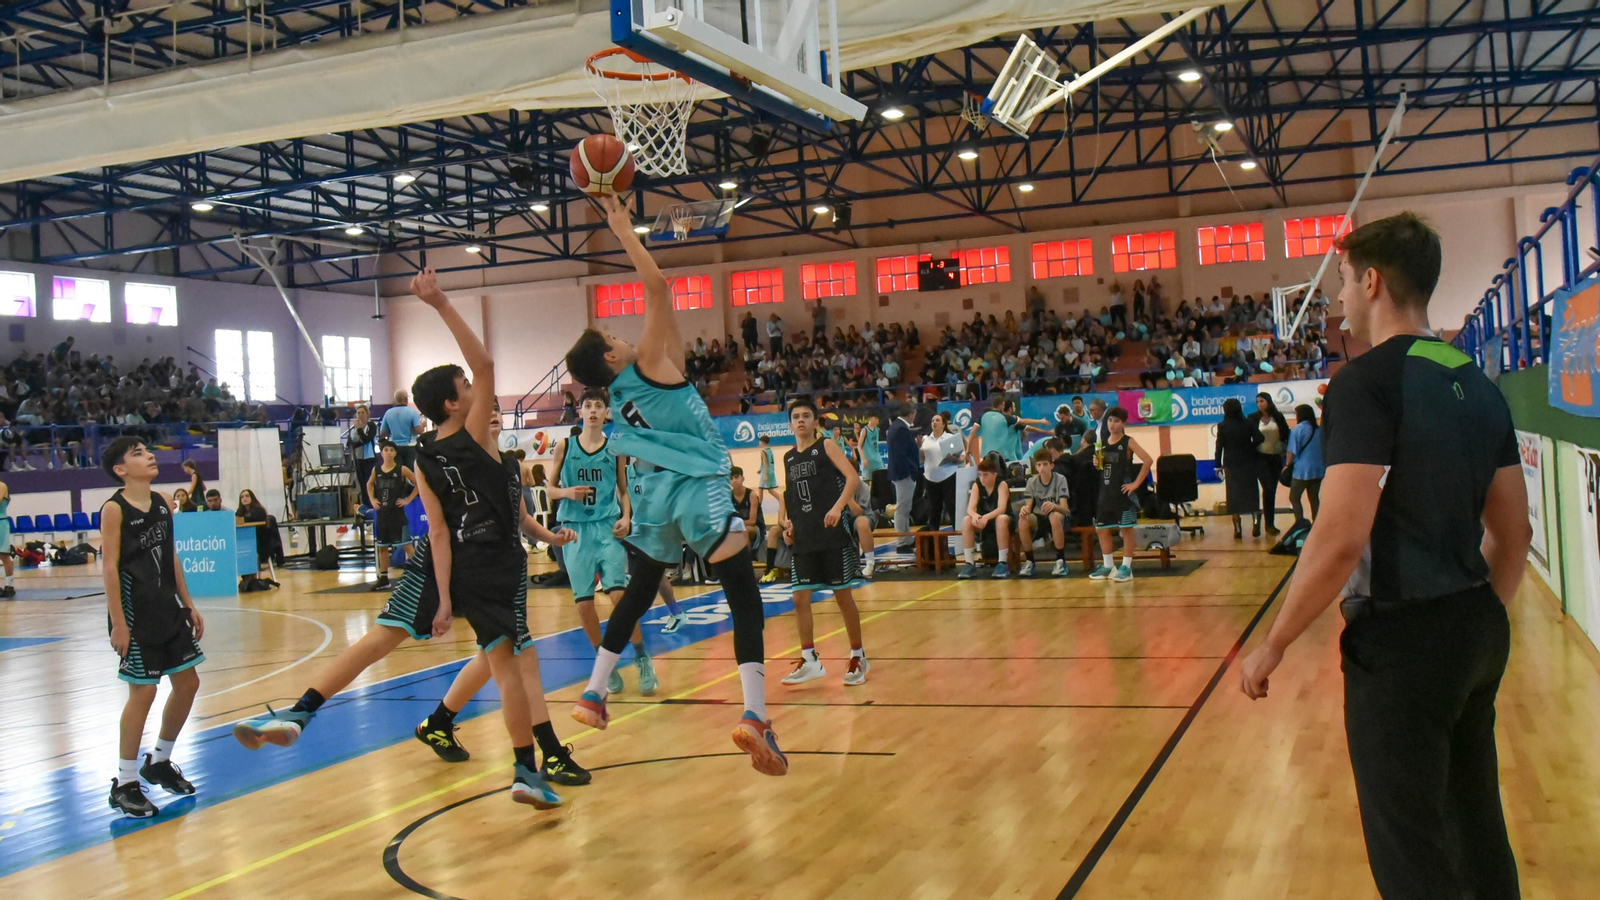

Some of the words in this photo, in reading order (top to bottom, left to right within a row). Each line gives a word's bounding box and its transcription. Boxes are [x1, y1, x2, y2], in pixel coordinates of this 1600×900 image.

[577, 468, 602, 481] ALM
[797, 480, 811, 502] 4
[175, 535, 226, 553] putación
[183, 557, 216, 573] Cádiz
